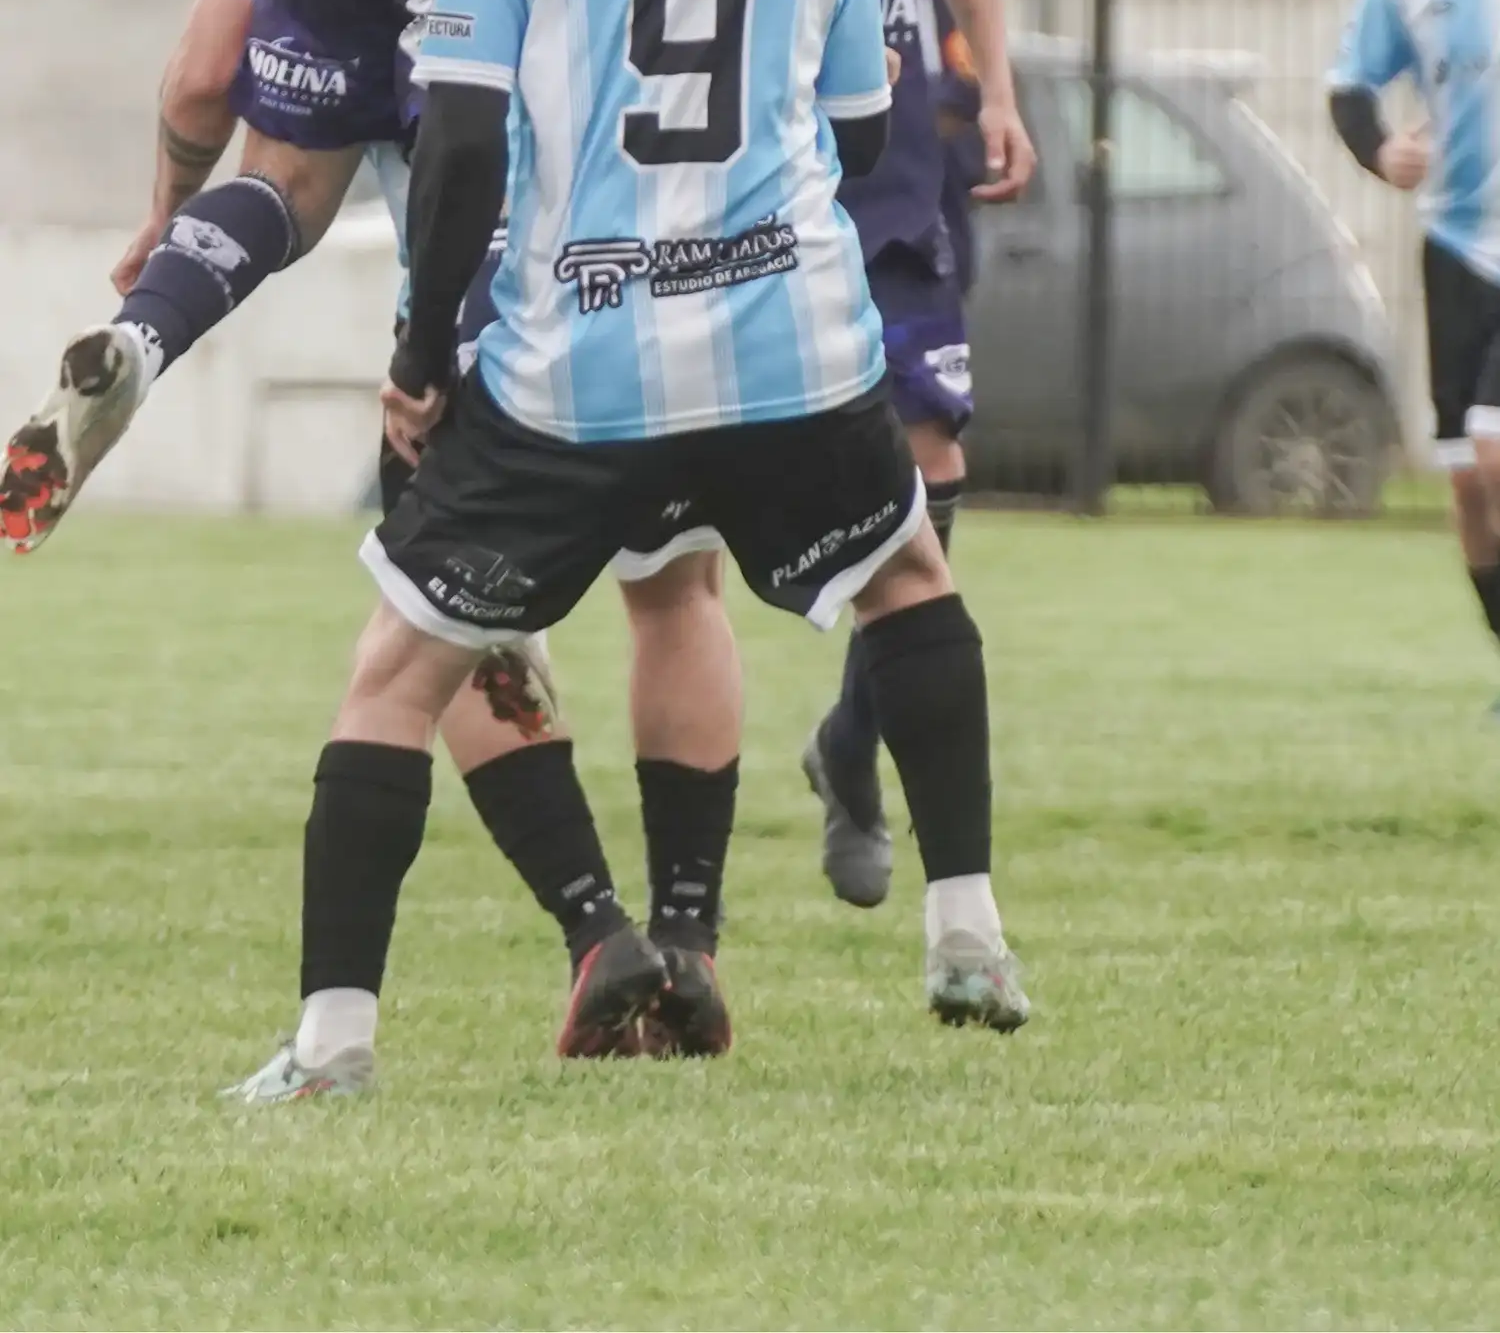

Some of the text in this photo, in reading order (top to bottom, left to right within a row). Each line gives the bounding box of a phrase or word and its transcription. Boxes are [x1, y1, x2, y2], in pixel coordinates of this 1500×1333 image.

[654, 274, 714, 295] ESTUDIO
[715, 268, 734, 285] DE
[771, 499, 898, 589] PLAN AZUL
[427, 576, 448, 601] EL
